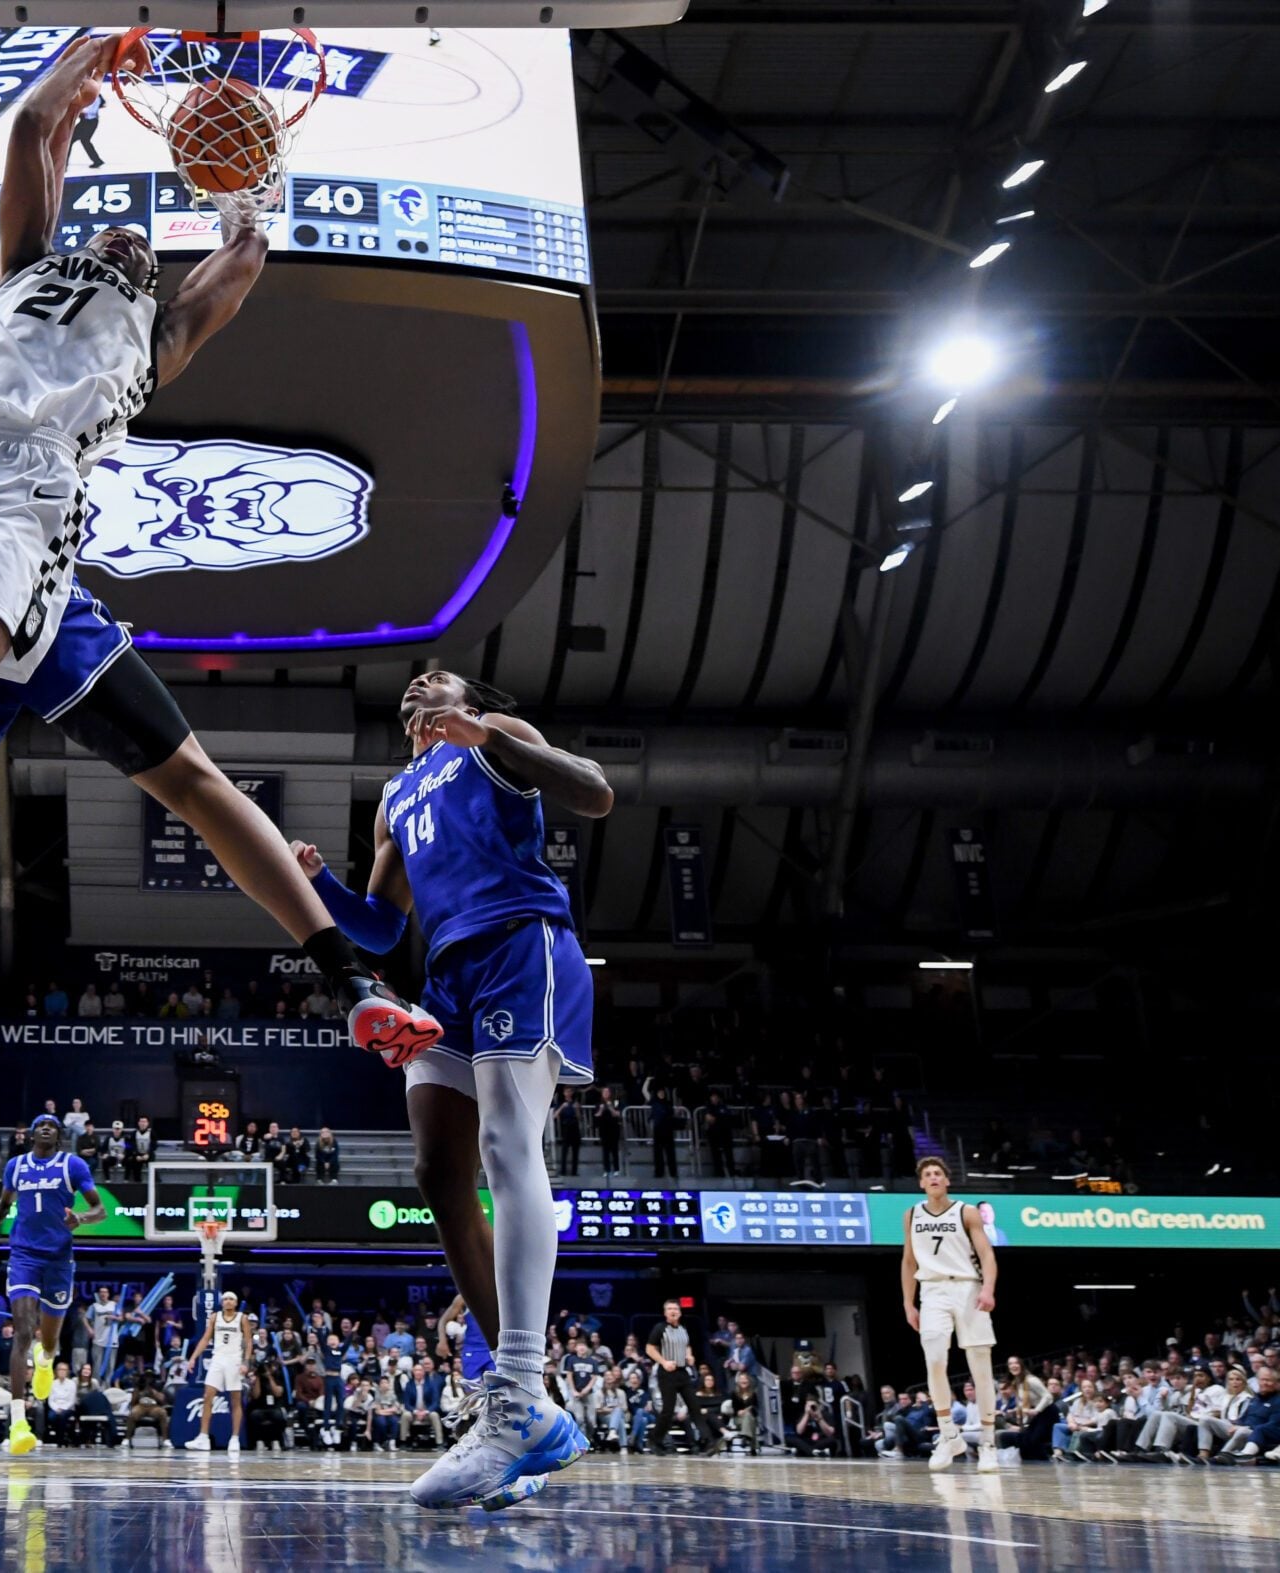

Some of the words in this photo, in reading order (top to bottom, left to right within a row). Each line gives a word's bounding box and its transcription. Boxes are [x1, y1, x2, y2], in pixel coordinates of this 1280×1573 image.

[73, 184, 132, 214] 45
[159, 188, 175, 205] 2
[304, 184, 364, 215] 40
[442, 197, 449, 208] 1
[62, 225, 81, 234] FLS
[169, 221, 211, 231] BIG
[65, 235, 77, 247] 4
[332, 234, 345, 247] 2
[362, 236, 376, 249] 6
[34, 256, 138, 303] DAWGS
[14, 283, 99, 326] 21
[235, 780, 264, 792] ST
[417, 757, 463, 802] Hall
[405, 803, 435, 856] 14
[546, 844, 577, 859] NCAA
[120, 954, 200, 969] Franciscan
[121, 971, 168, 982] HEALTH
[1, 1025, 123, 1045] WELCOME
[131, 1026, 165, 1045] TO
[171, 1027, 259, 1046] HINKLE
[264, 1028, 354, 1048] FIELDH
[199, 1102, 230, 1119] 9:56
[194, 1118, 227, 1145] 24
[34, 1192, 42, 1212] 1
[843, 1204, 852, 1213] 4
[115, 1207, 147, 1216] FUE
[157, 1207, 185, 1216] FOR
[1021, 1207, 1265, 1230] CountOnGreen.com
[649, 1227, 659, 1237] 7
[682, 1227, 689, 1237] 1
[915, 1223, 957, 1233] DAWGS
[932, 1236, 944, 1255] 7
